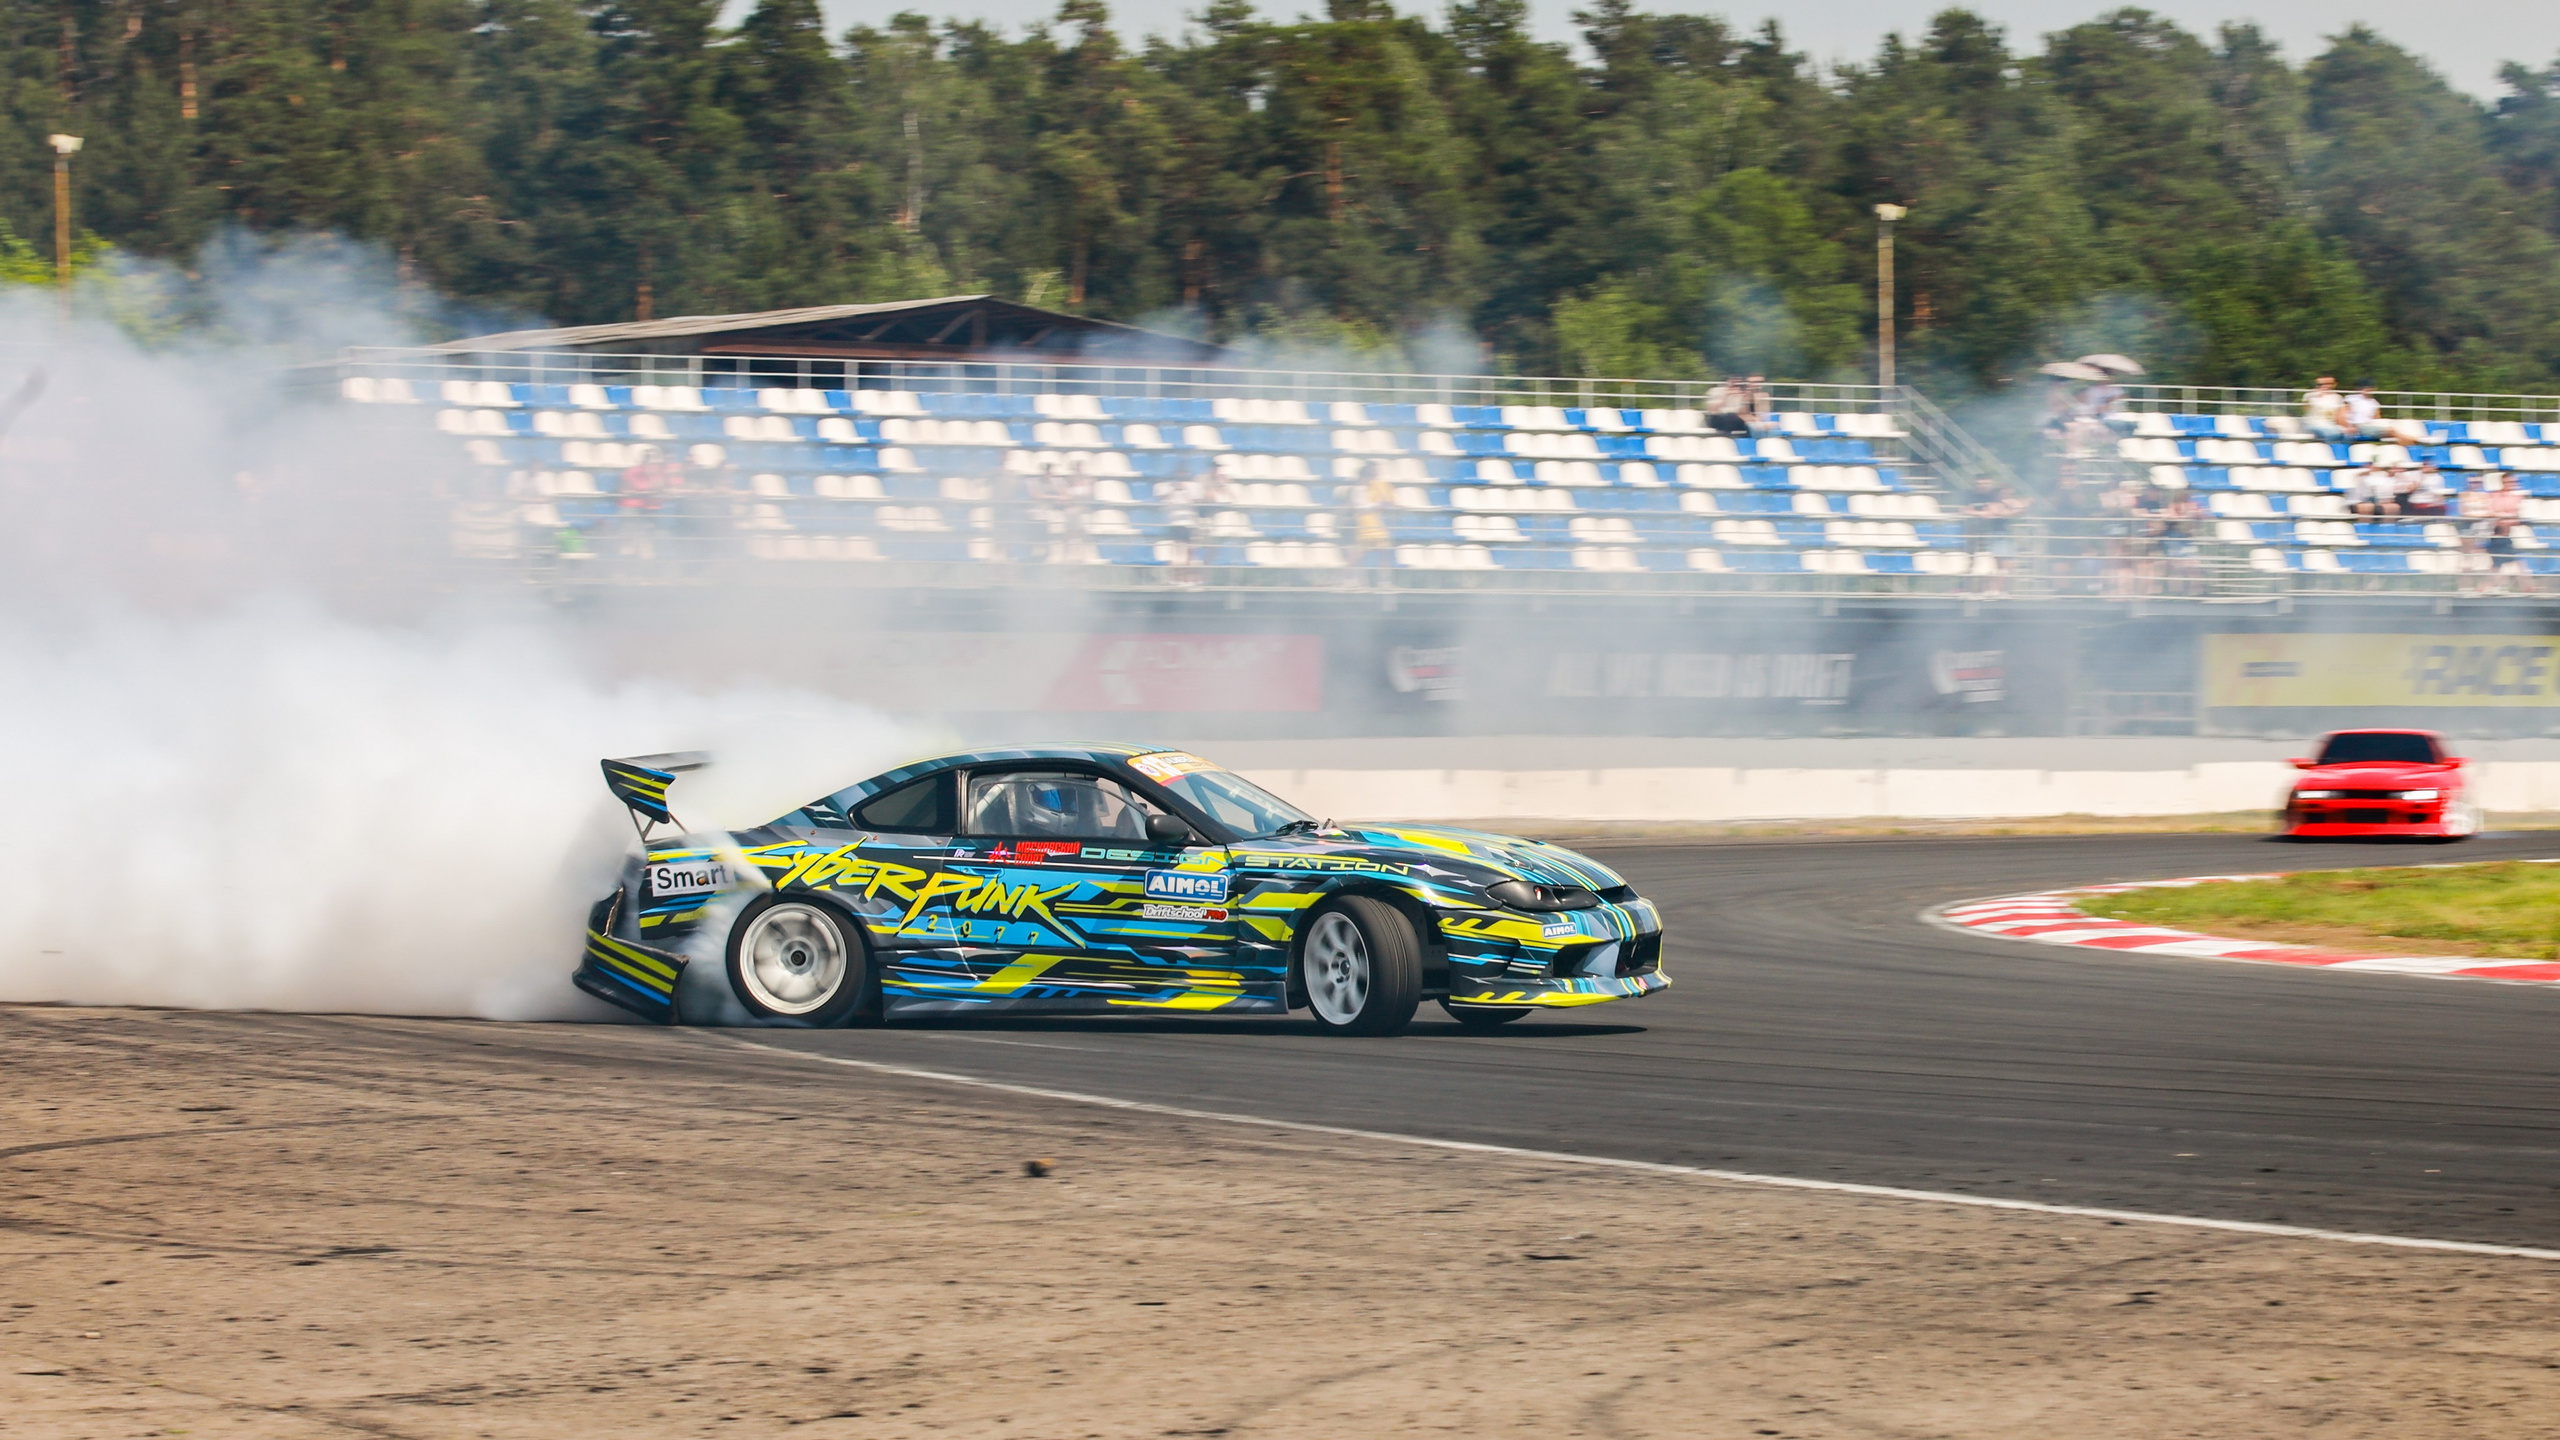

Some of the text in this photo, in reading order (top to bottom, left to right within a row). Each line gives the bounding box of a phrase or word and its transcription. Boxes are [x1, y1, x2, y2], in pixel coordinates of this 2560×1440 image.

[1080, 847, 1409, 875] DESIGN STATION
[657, 865, 728, 889] Smart
